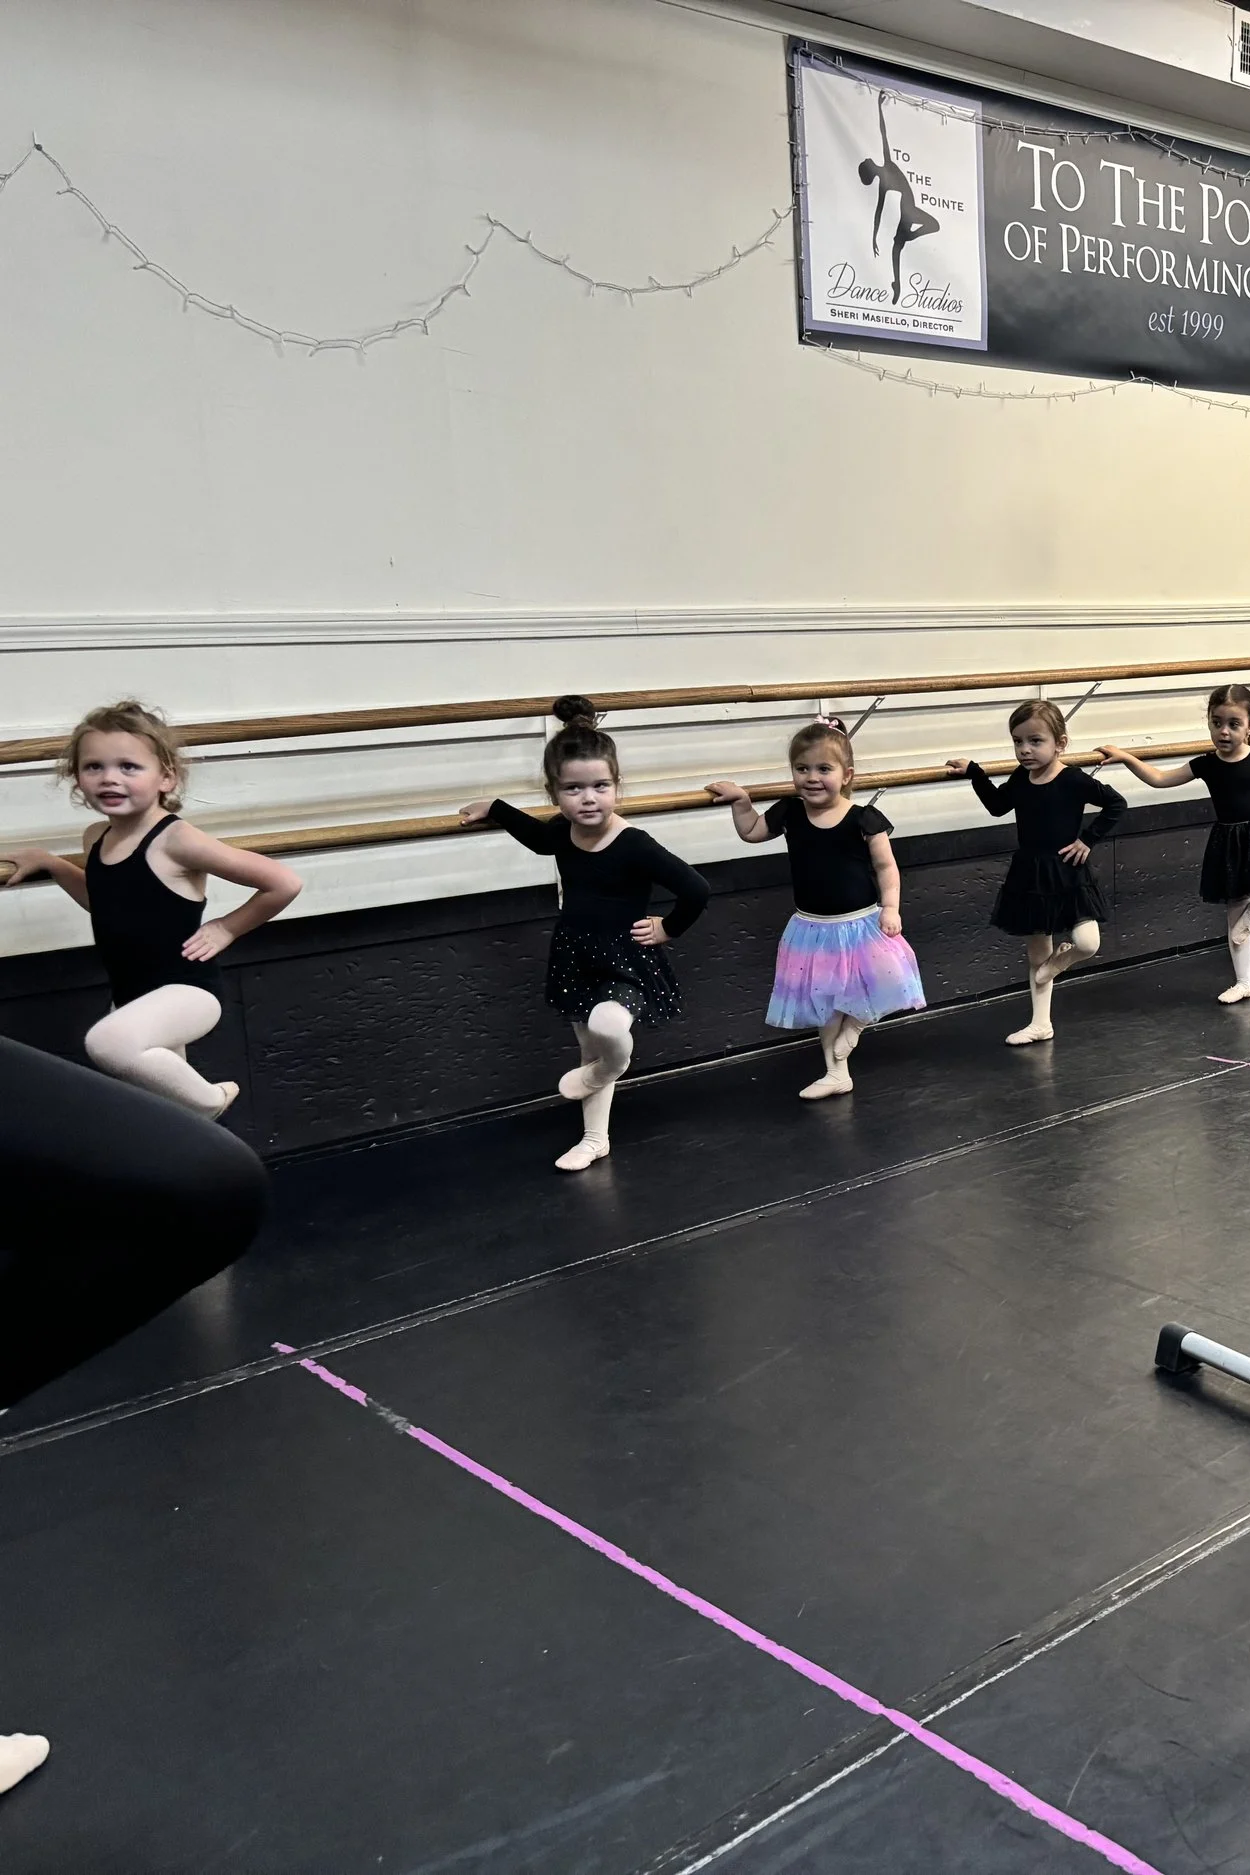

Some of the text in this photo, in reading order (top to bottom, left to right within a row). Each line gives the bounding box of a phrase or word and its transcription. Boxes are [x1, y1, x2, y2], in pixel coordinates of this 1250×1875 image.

[893, 148, 911, 162] TO
[907, 171, 932, 187] THE
[1017, 139, 1086, 212] TO
[1100, 159, 1187, 234] THE
[921, 193, 965, 212] POINTE
[1004, 221, 1048, 264] OF
[827, 262, 964, 313] Dance Studios
[830, 308, 955, 333] SHERI MASIELLO, DIRECTOR
[1148, 306, 1225, 341] est 1999
